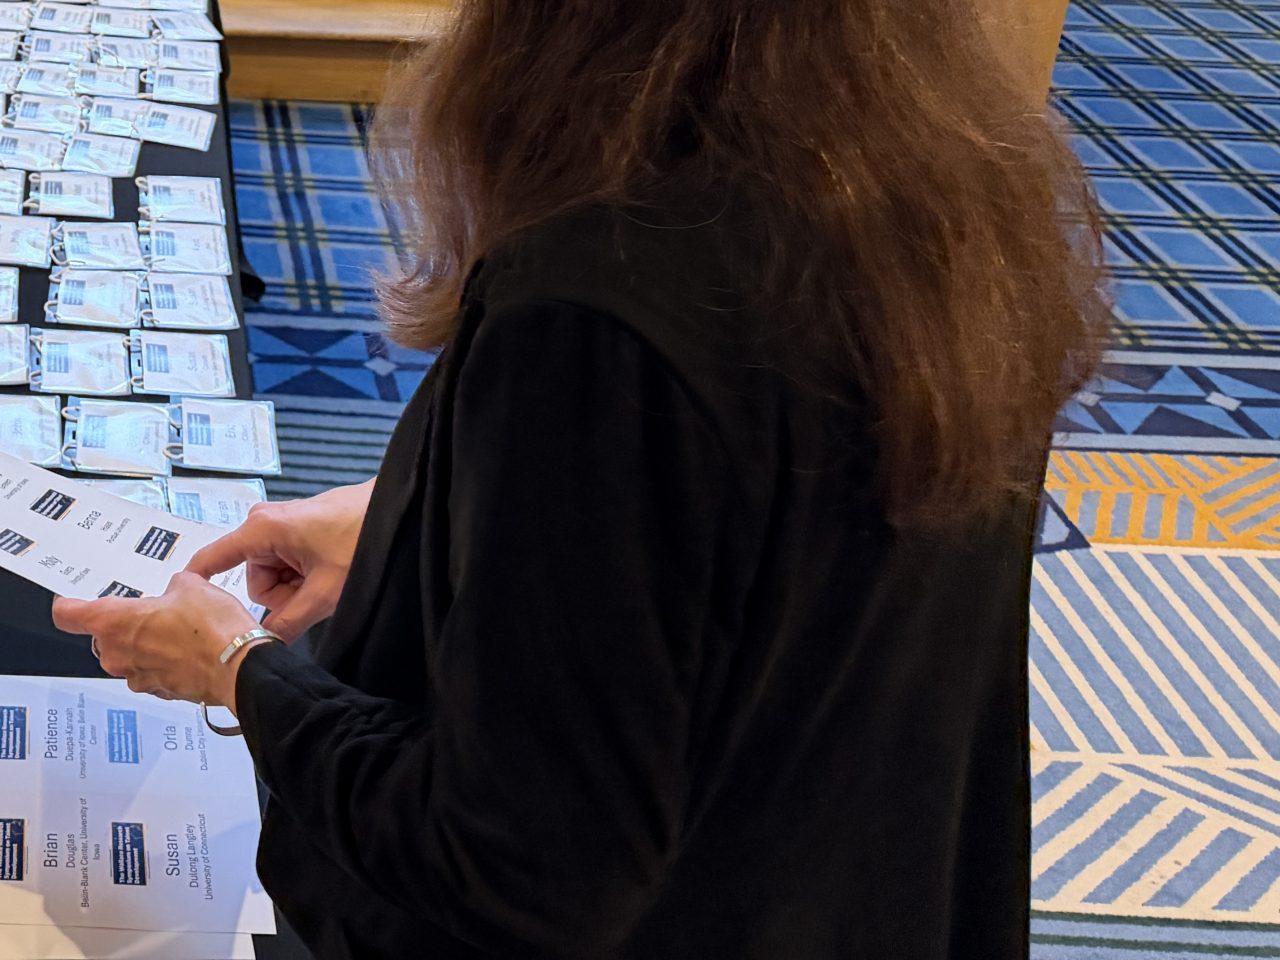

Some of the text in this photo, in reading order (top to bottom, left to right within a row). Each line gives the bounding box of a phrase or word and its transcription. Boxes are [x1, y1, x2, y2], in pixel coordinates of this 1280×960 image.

[44, 708, 58, 759] Patience
[164, 725, 178, 751] Orla
[79, 746, 87, 779] University
[80, 798, 88, 806] of
[80, 806, 88, 839] University
[44, 833, 58, 868] Brian
[66, 834, 77, 868] Douglas
[166, 834, 180, 876] Susan
[187, 823, 199, 888] Dulong Langley
[198, 813, 213, 900] University of Connecticut
[81, 864, 89, 908] Belin-Blank
